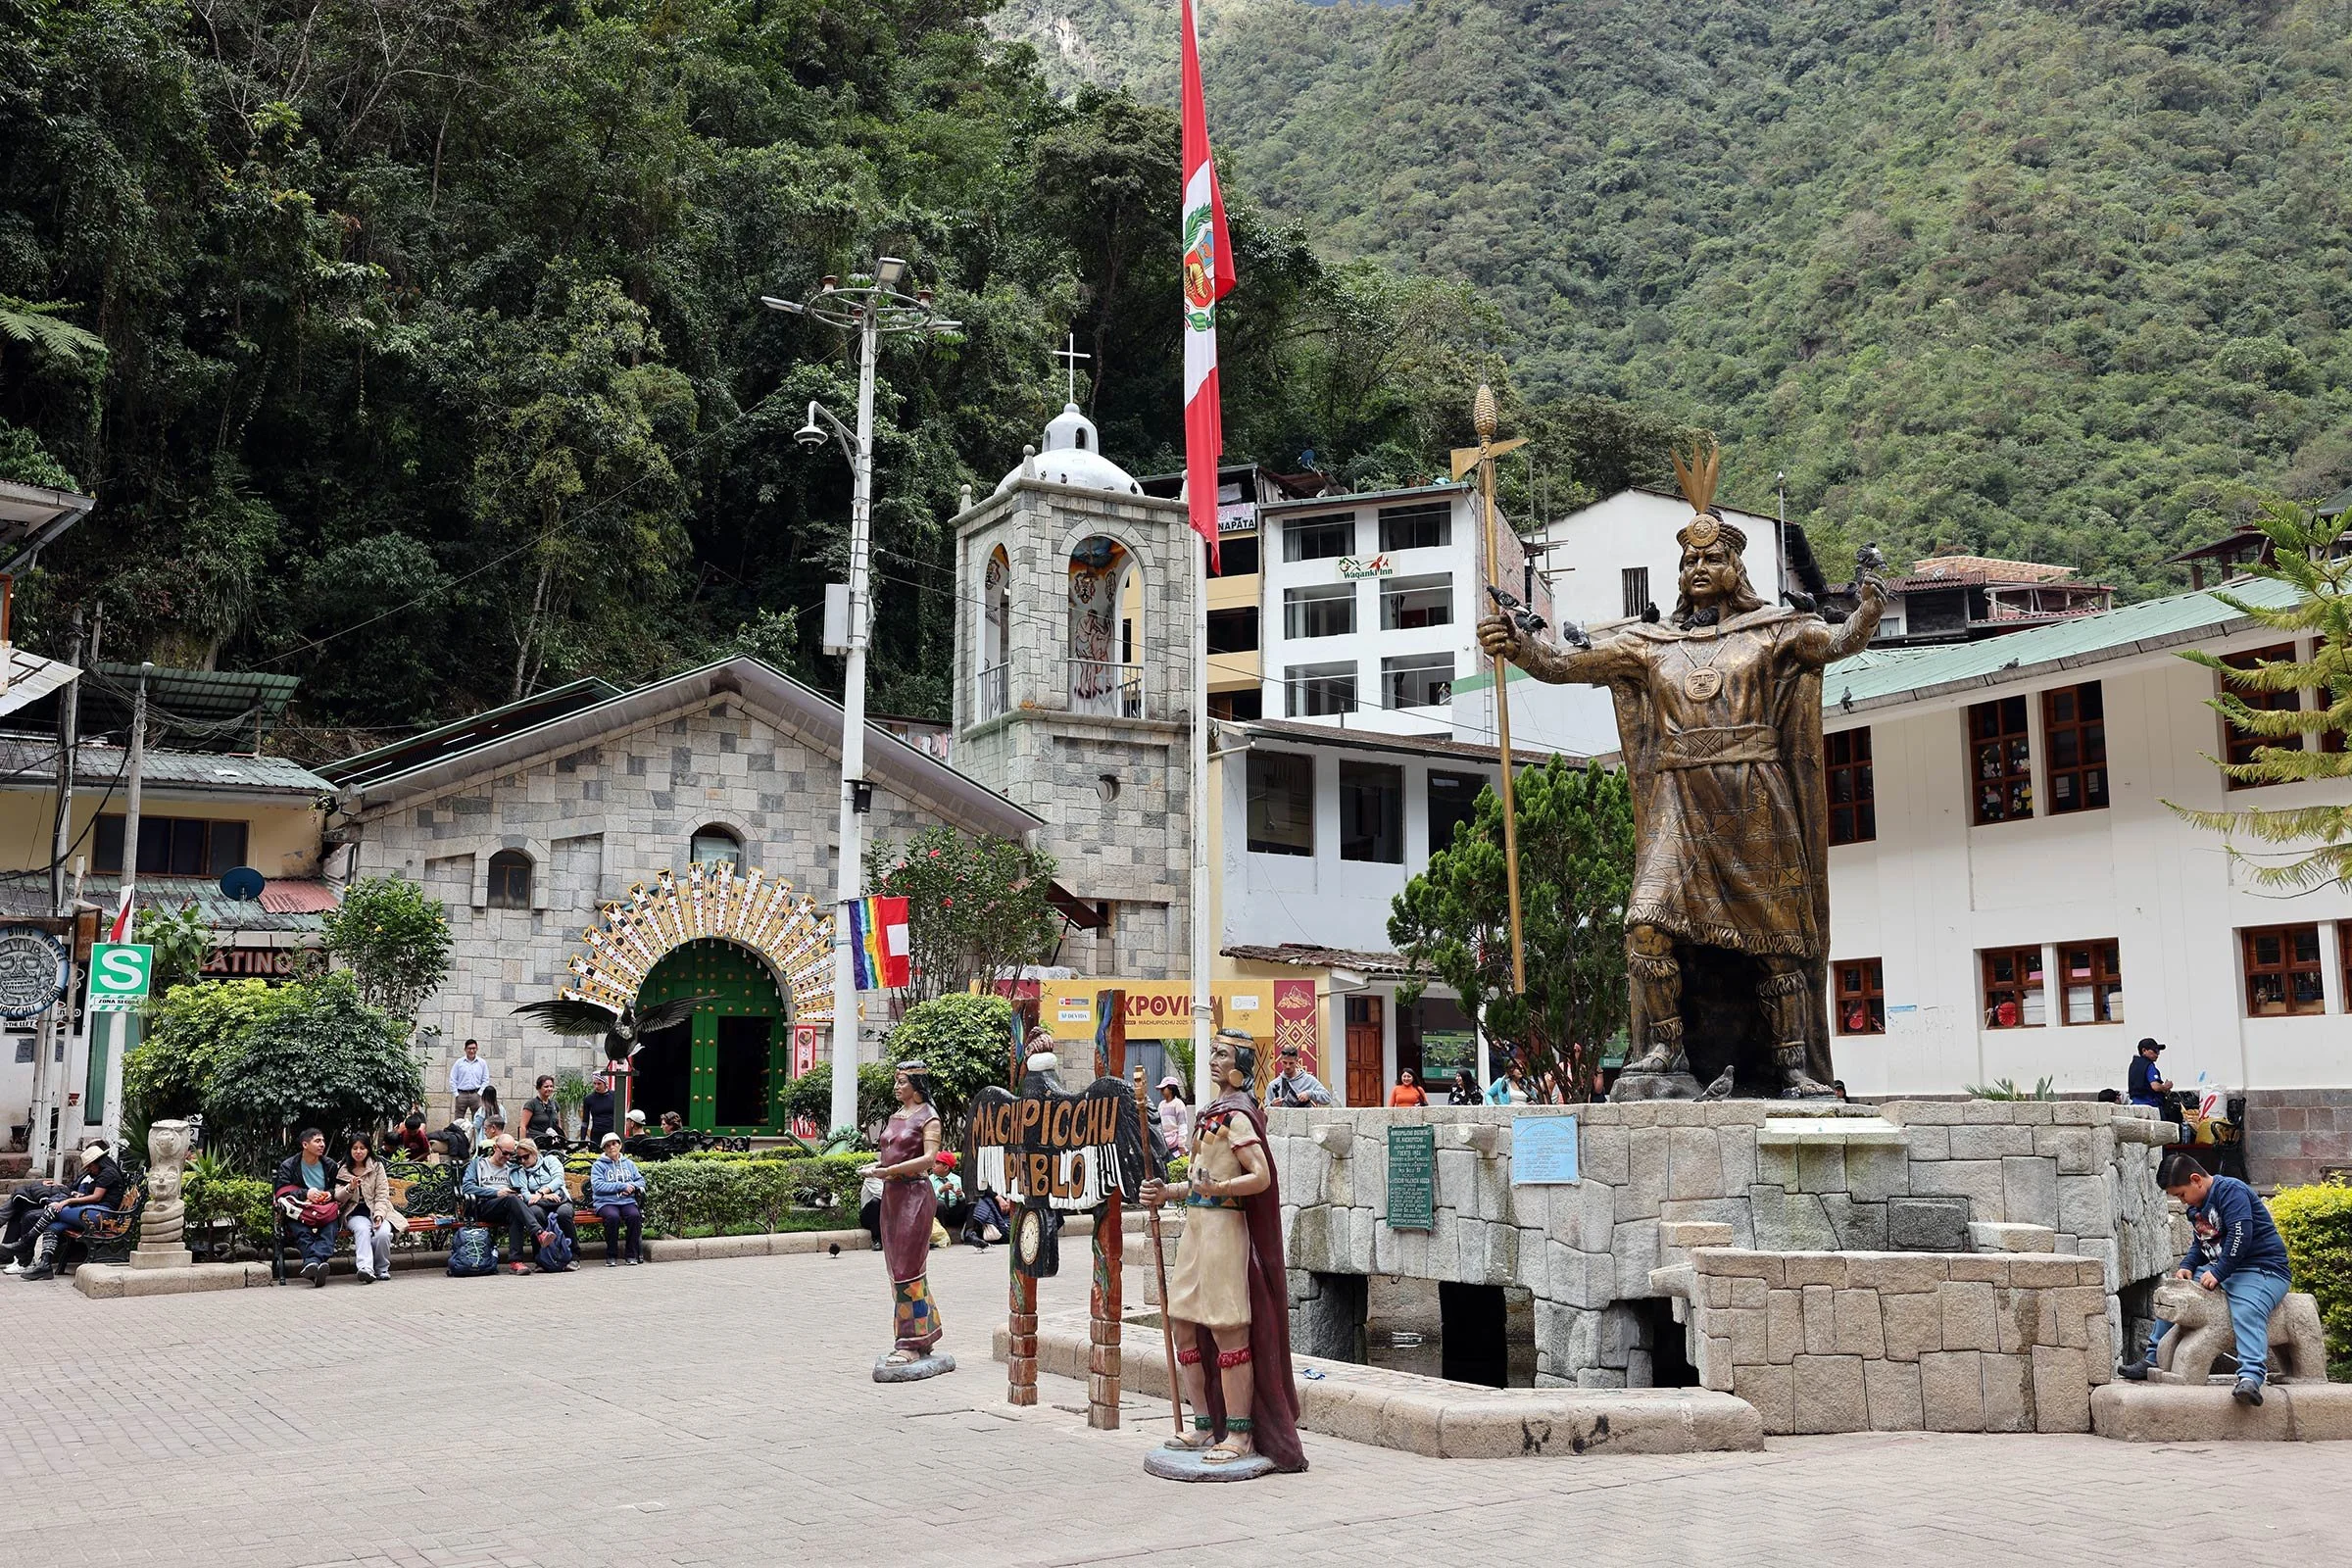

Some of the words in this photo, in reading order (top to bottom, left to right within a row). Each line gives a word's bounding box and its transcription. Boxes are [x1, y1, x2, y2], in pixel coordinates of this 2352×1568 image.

[1218, 519, 1254, 530] NAPATA
[98, 949, 143, 991] S
[0, 1004, 35, 1017] PICCHU
